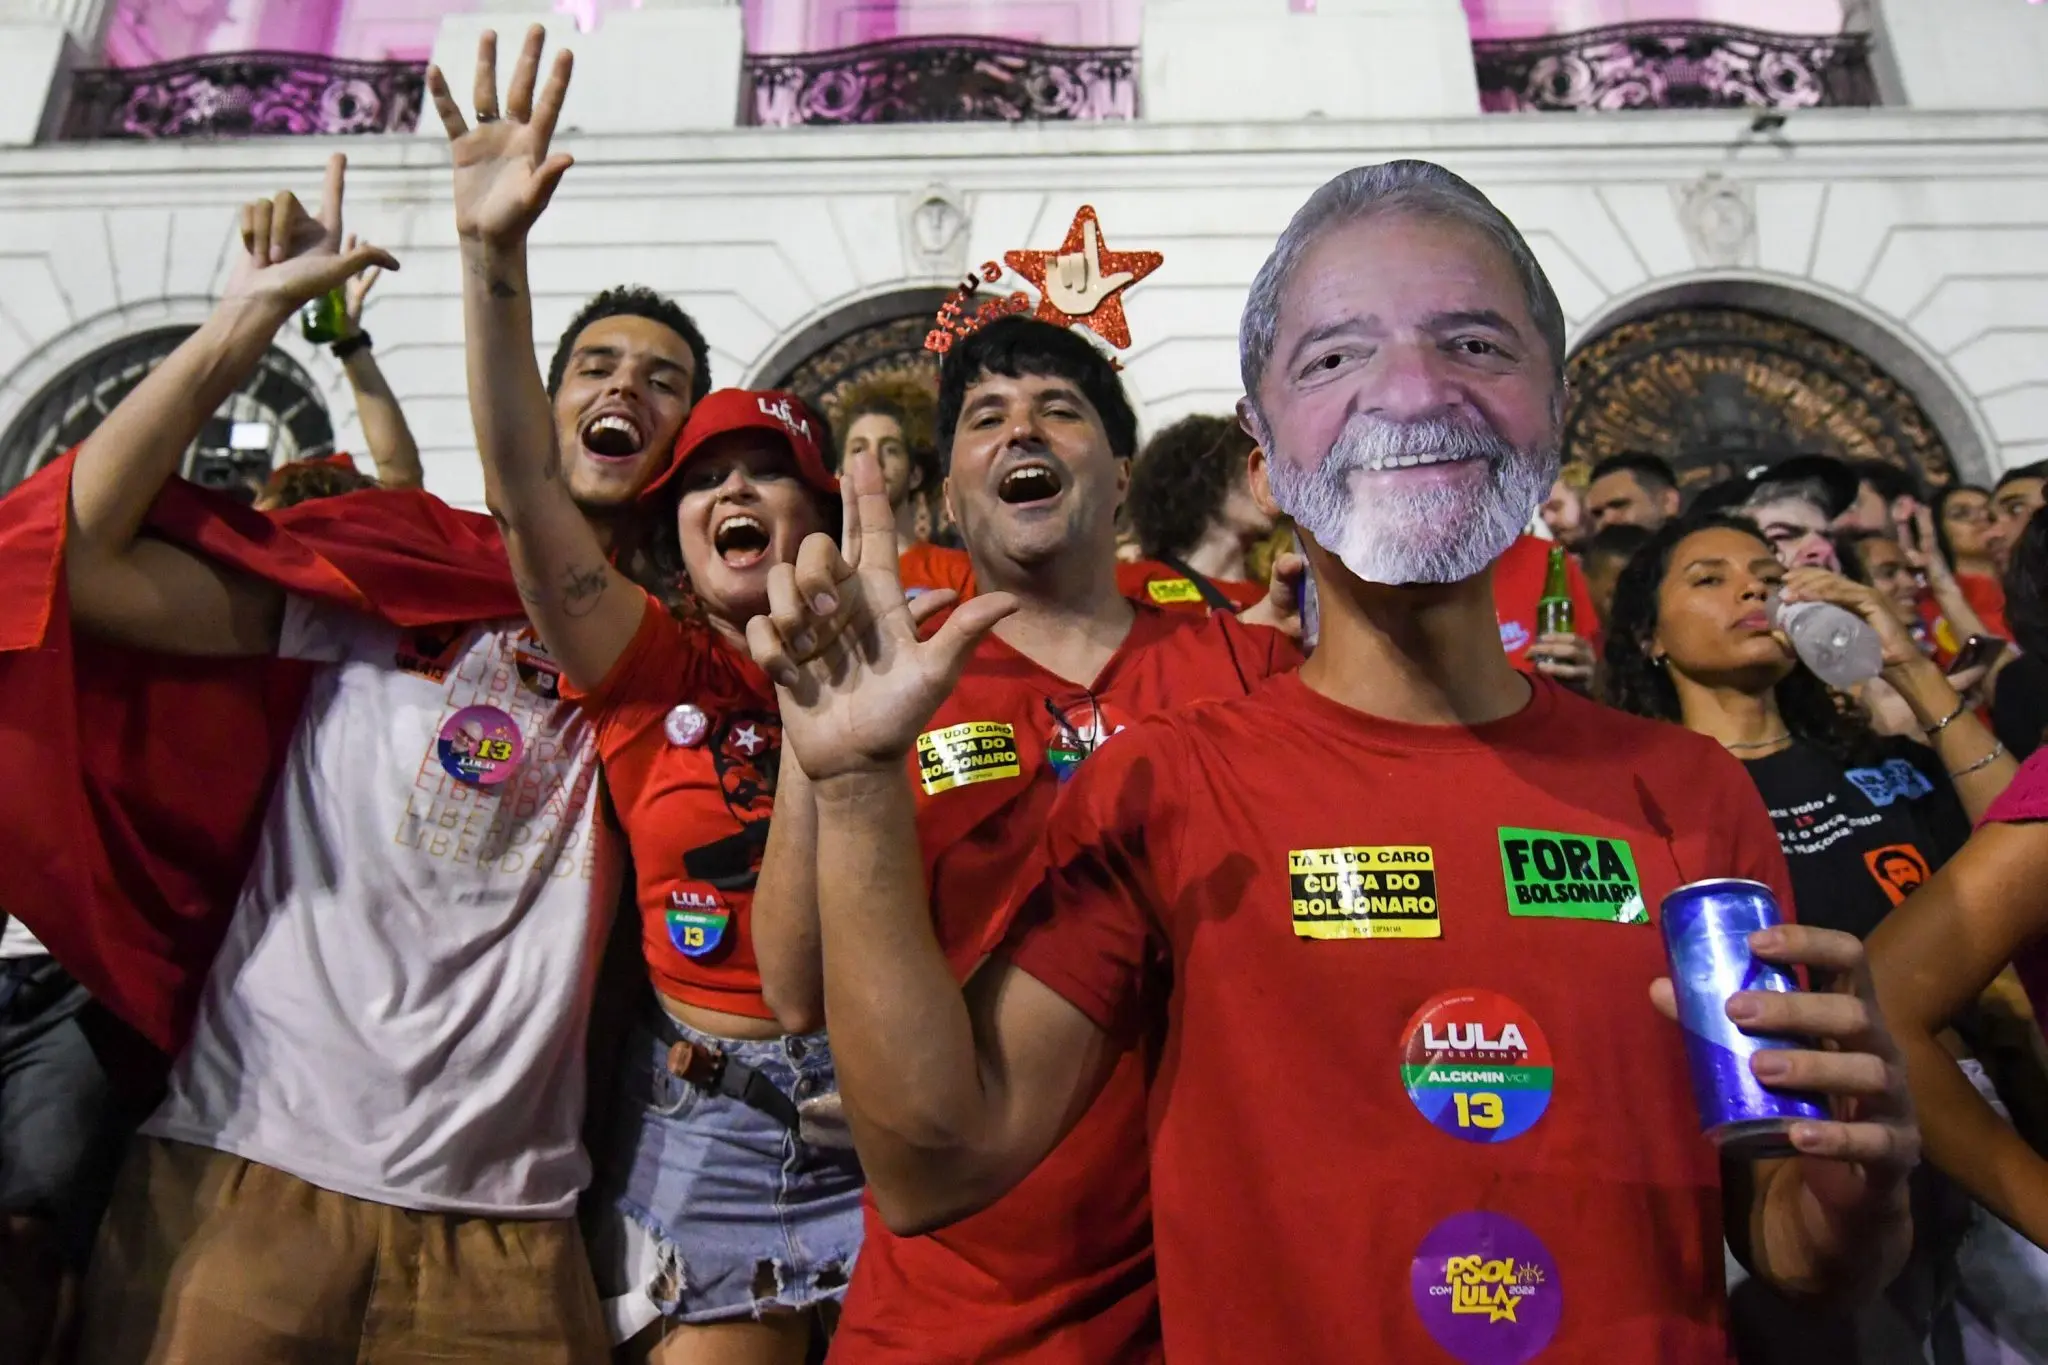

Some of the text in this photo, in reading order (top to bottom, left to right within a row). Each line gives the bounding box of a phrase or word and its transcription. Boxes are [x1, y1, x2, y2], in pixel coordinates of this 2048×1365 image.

[975, 725, 1012, 735] CARO
[477, 739, 512, 761] 13
[927, 738, 1006, 762] CLPA DO
[1768, 809, 1788, 818] eu
[1790, 801, 1824, 816] voto
[1377, 851, 1430, 863] CARO
[1503, 838, 1631, 881] FORA
[1386, 873, 1420, 890] DO
[672, 890, 716, 908] LULA
[1515, 882, 1637, 905] BOLSONARO
[1293, 896, 1436, 916] BOLSONARO
[684, 926, 704, 947] 13
[1423, 1022, 1528, 1051] LULA
[1425, 1050, 1529, 1059] PRESIDENTE
[1428, 1070, 1530, 1084] ALCKMIN VICE
[1453, 1092, 1505, 1129] 13
[1445, 1254, 1518, 1285] PSOL
[1429, 1286, 1452, 1296] COM
[1452, 1276, 1522, 1324] LULA
[1508, 1286, 1536, 1296] 2022
